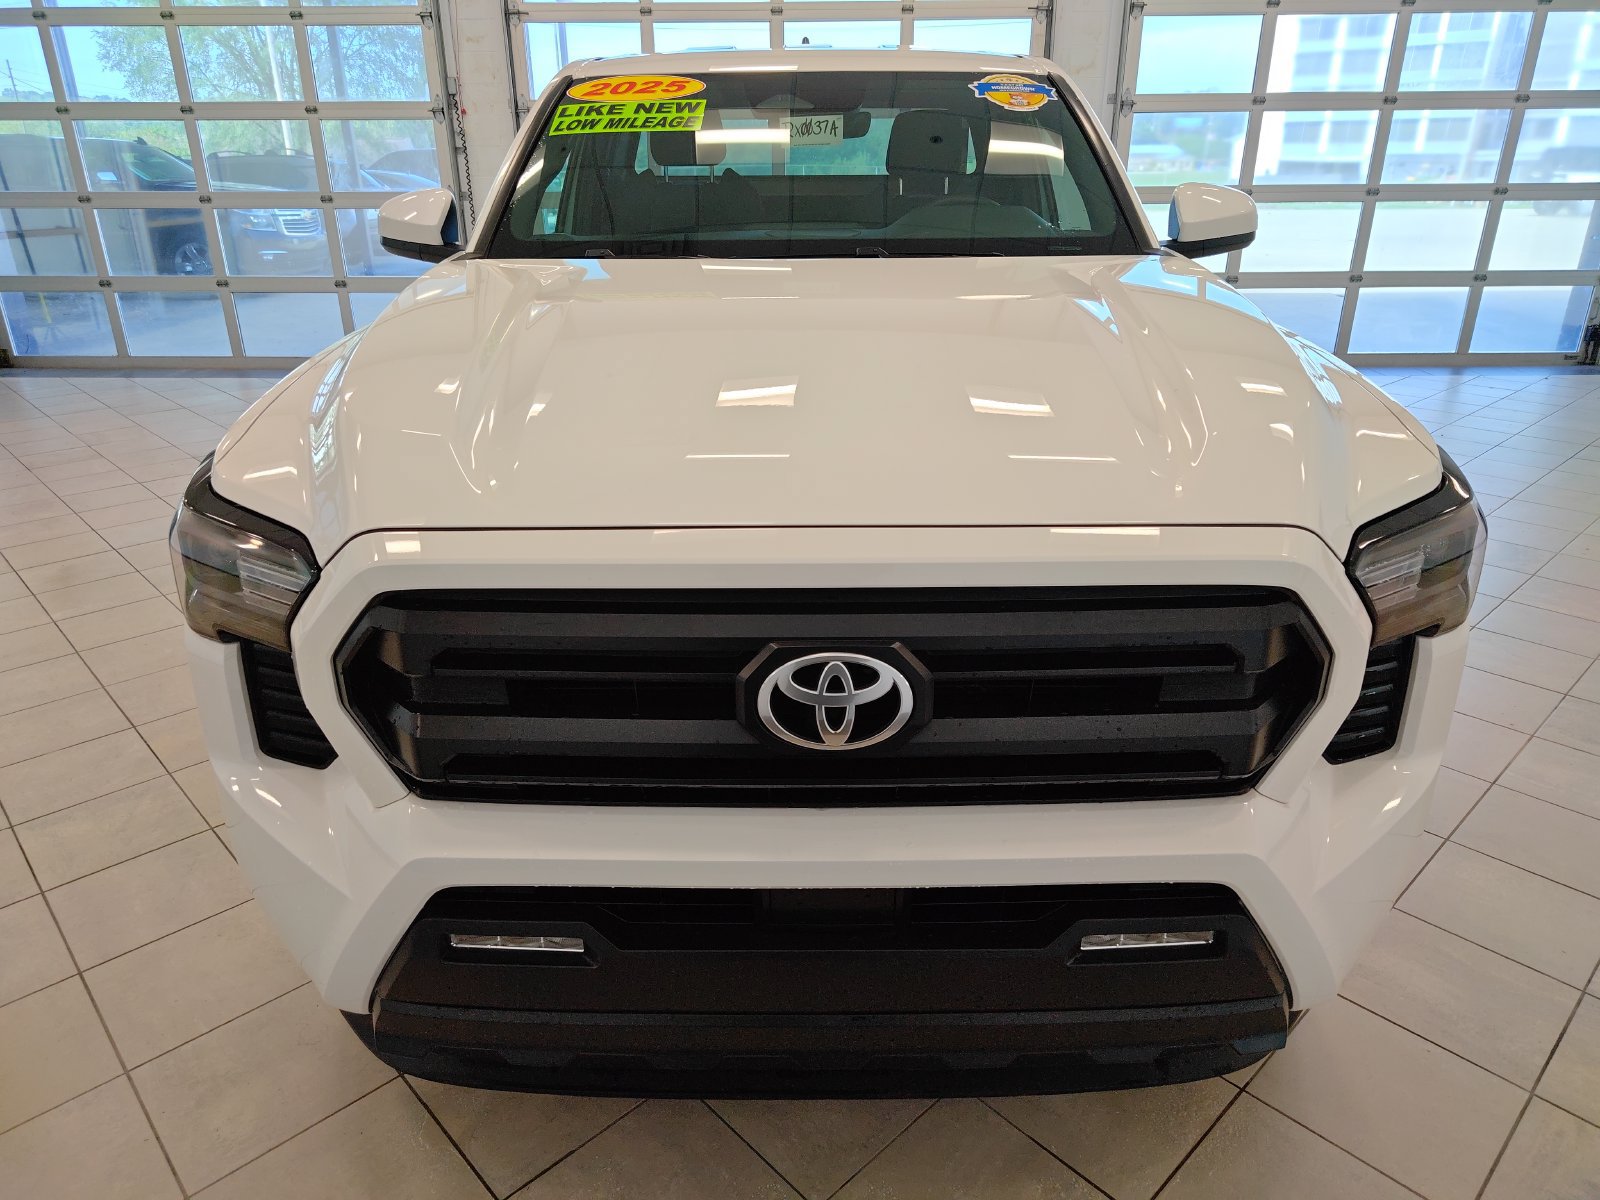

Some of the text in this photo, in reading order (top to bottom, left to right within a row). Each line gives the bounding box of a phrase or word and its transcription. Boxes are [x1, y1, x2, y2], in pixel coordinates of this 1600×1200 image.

[580, 81, 691, 97] 2025
[557, 102, 703, 118] LIKE NEW
[553, 116, 697, 133] LOW MILEAGE
